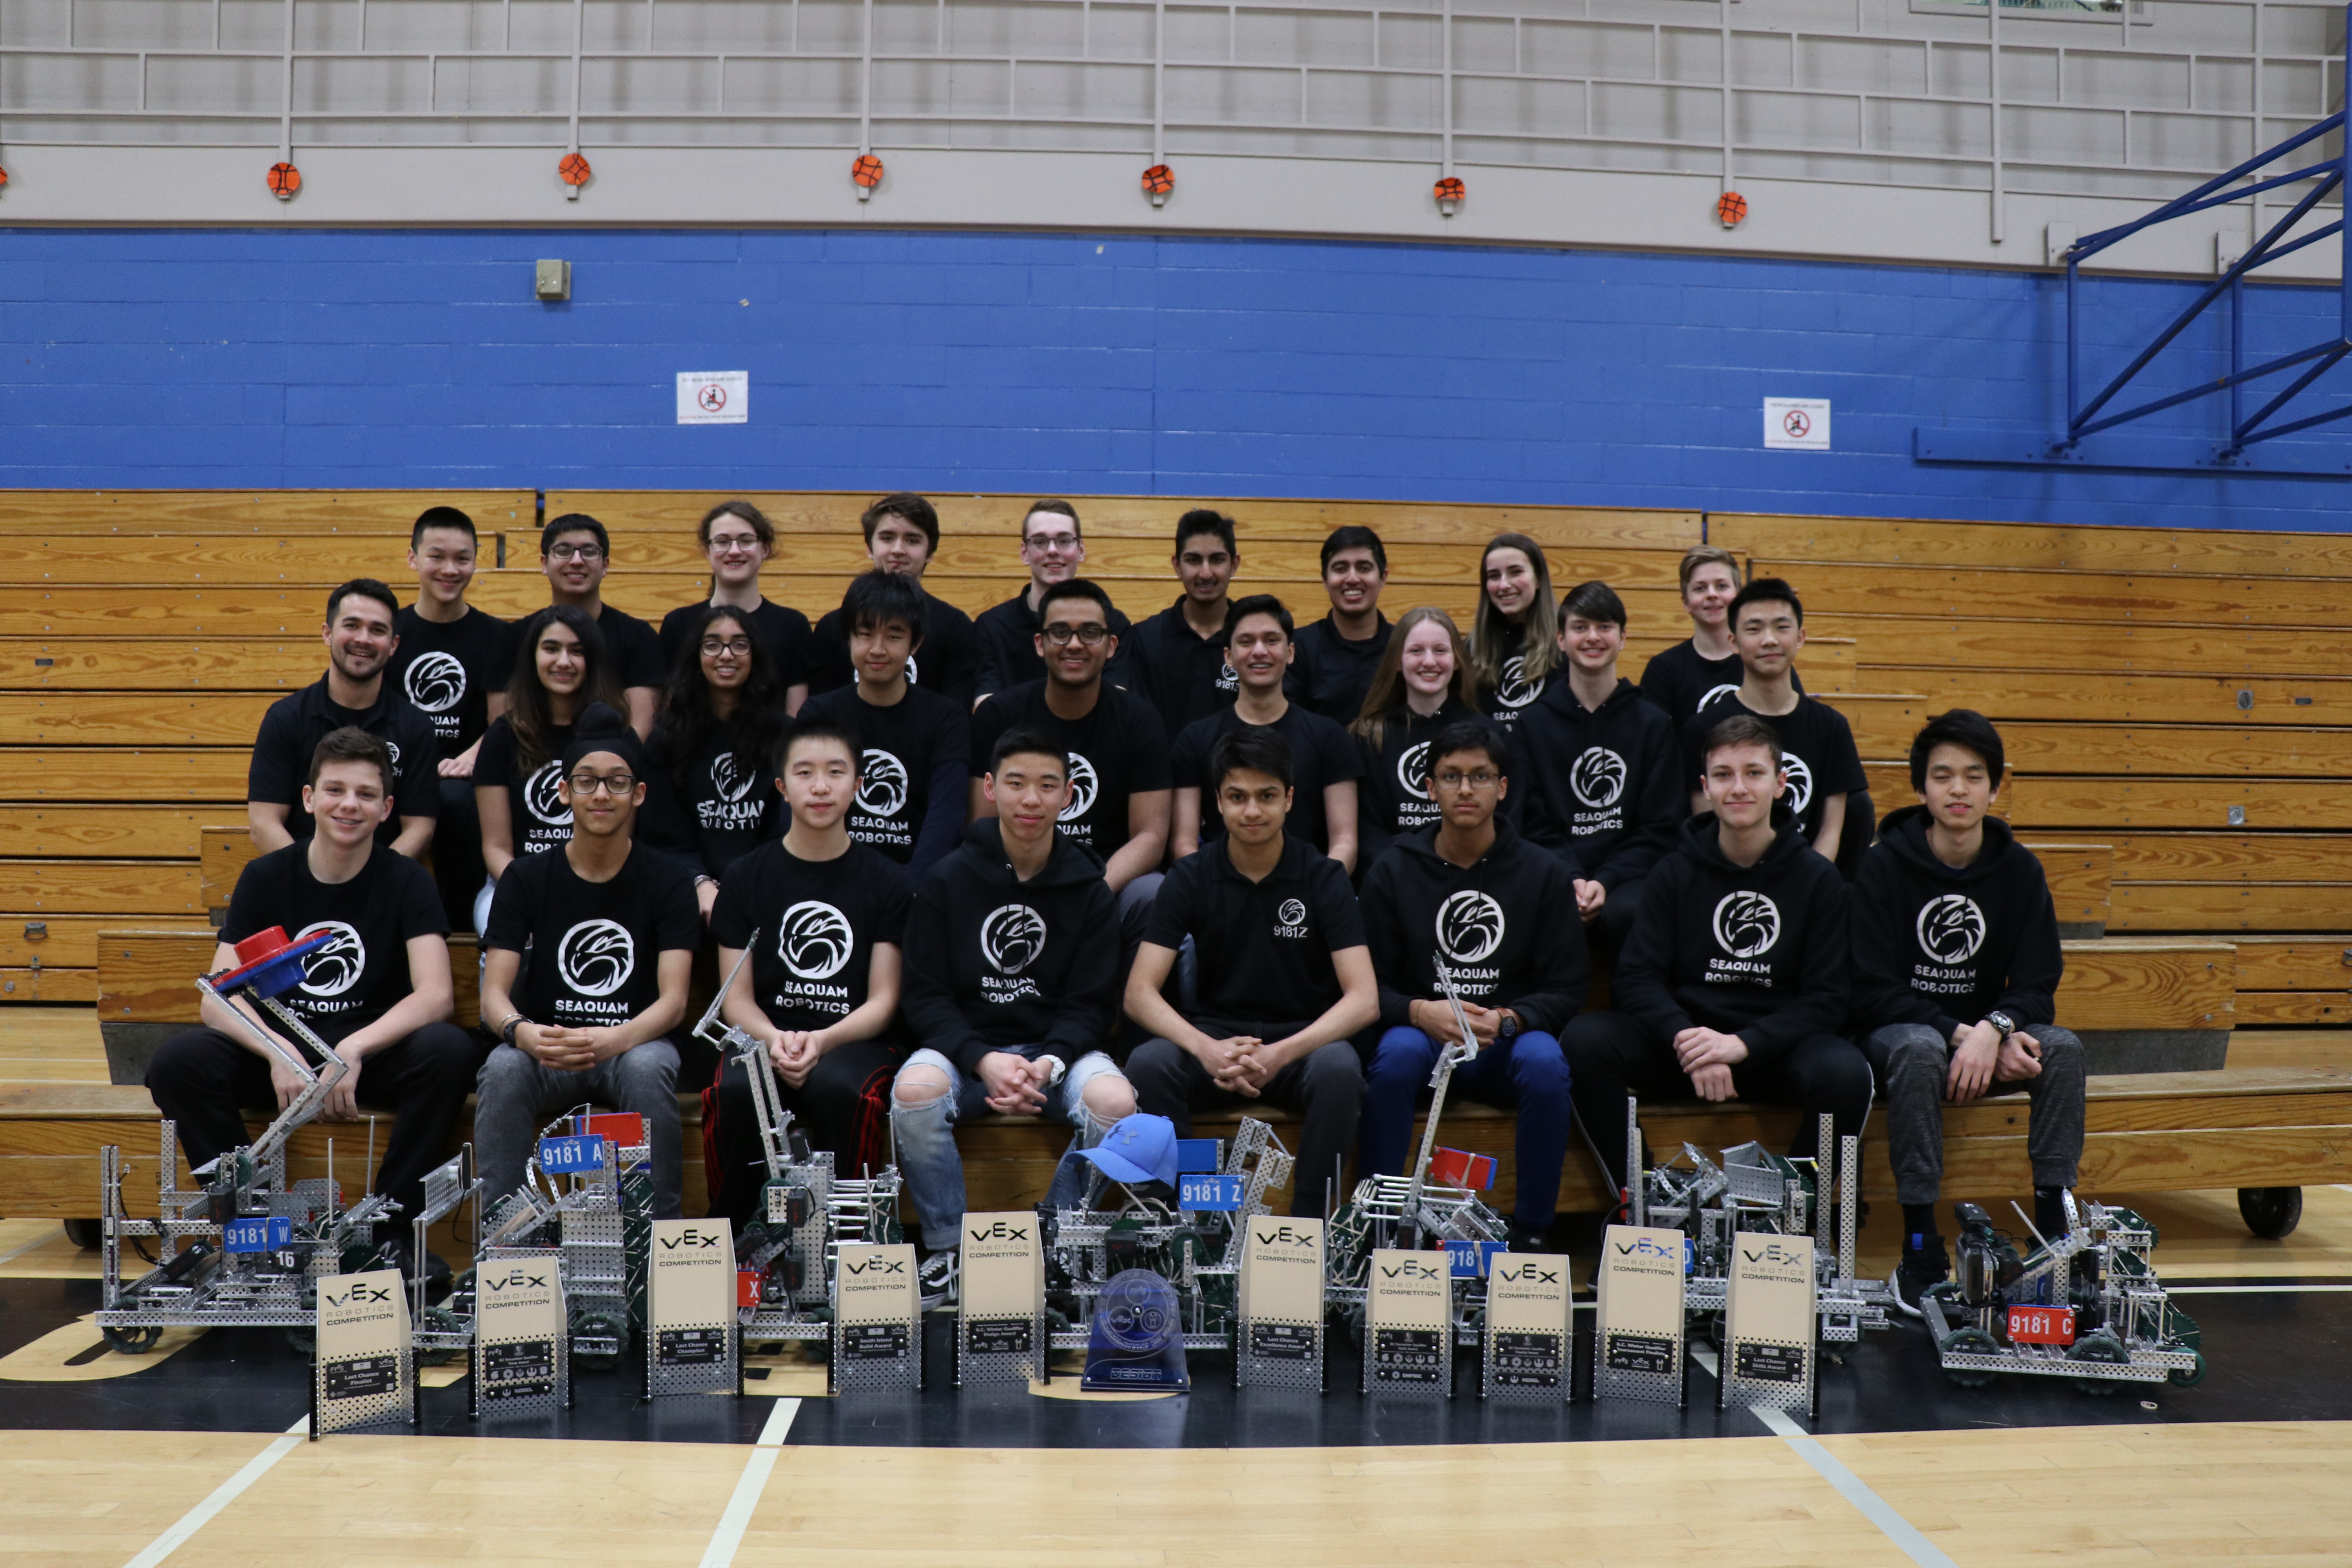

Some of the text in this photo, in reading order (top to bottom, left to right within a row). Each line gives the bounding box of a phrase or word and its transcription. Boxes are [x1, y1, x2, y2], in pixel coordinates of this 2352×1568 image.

[1573, 806, 1622, 822] SEAQUAM
[851, 816, 908, 831] SEAQUAM
[1572, 819, 1623, 835] ROBOTICS
[848, 831, 912, 845] ROBOTICS
[1274, 926, 1308, 938] 9181Z
[1709, 958, 1771, 974] SEAQUAM
[1915, 964, 1976, 979] SEAQUAM
[982, 976, 1035, 989] SEAQUAM
[1705, 972, 1772, 987] ROBOTICS
[1910, 978, 1975, 993] ROBOTICS
[784, 981, 848, 998] SEAQUAM
[980, 985, 1041, 1003] ROBOTICS
[290, 999, 363, 1013] SEAQUAM
[555, 999, 629, 1013] SEAQUAM
[775, 995, 850, 1014] ROBOTICS
[543, 1143, 603, 1165] 9181 A
[1183, 1185, 1241, 1202] 9181 Z
[227, 1227, 288, 1245] 9181 W
[660, 1229, 720, 1249] VEX
[970, 1222, 1029, 1241] VEX
[1256, 1227, 1315, 1248] VEX
[1256, 1247, 1316, 1257] ROBOTICS
[1615, 1237, 1675, 1259] VEX
[1742, 1244, 1804, 1267] VEX
[276, 1250, 294, 1267] 16
[846, 1255, 905, 1274] VEX
[1256, 1255, 1316, 1264] COMPETITION
[1614, 1258, 1675, 1269] ROBOTICS
[1381, 1260, 1440, 1280] VEX
[1499, 1263, 1559, 1284] VEX
[1613, 1266, 1675, 1276] COMPETITION
[1742, 1265, 1805, 1276] ROBOTICS
[485, 1269, 548, 1291] VEX
[1741, 1273, 1805, 1284] COMPETITION
[325, 1283, 391, 1307] VEX
[485, 1291, 550, 1301] ROBOTICS
[750, 1281, 759, 1298] X
[326, 1305, 394, 1318] ROBOTICS
[485, 1298, 550, 1309] COMPETITION
[327, 1313, 394, 1326] COMPETITION
[2011, 1315, 2072, 1334] 9181 C
[1110, 1368, 1162, 1380] DESIGN
